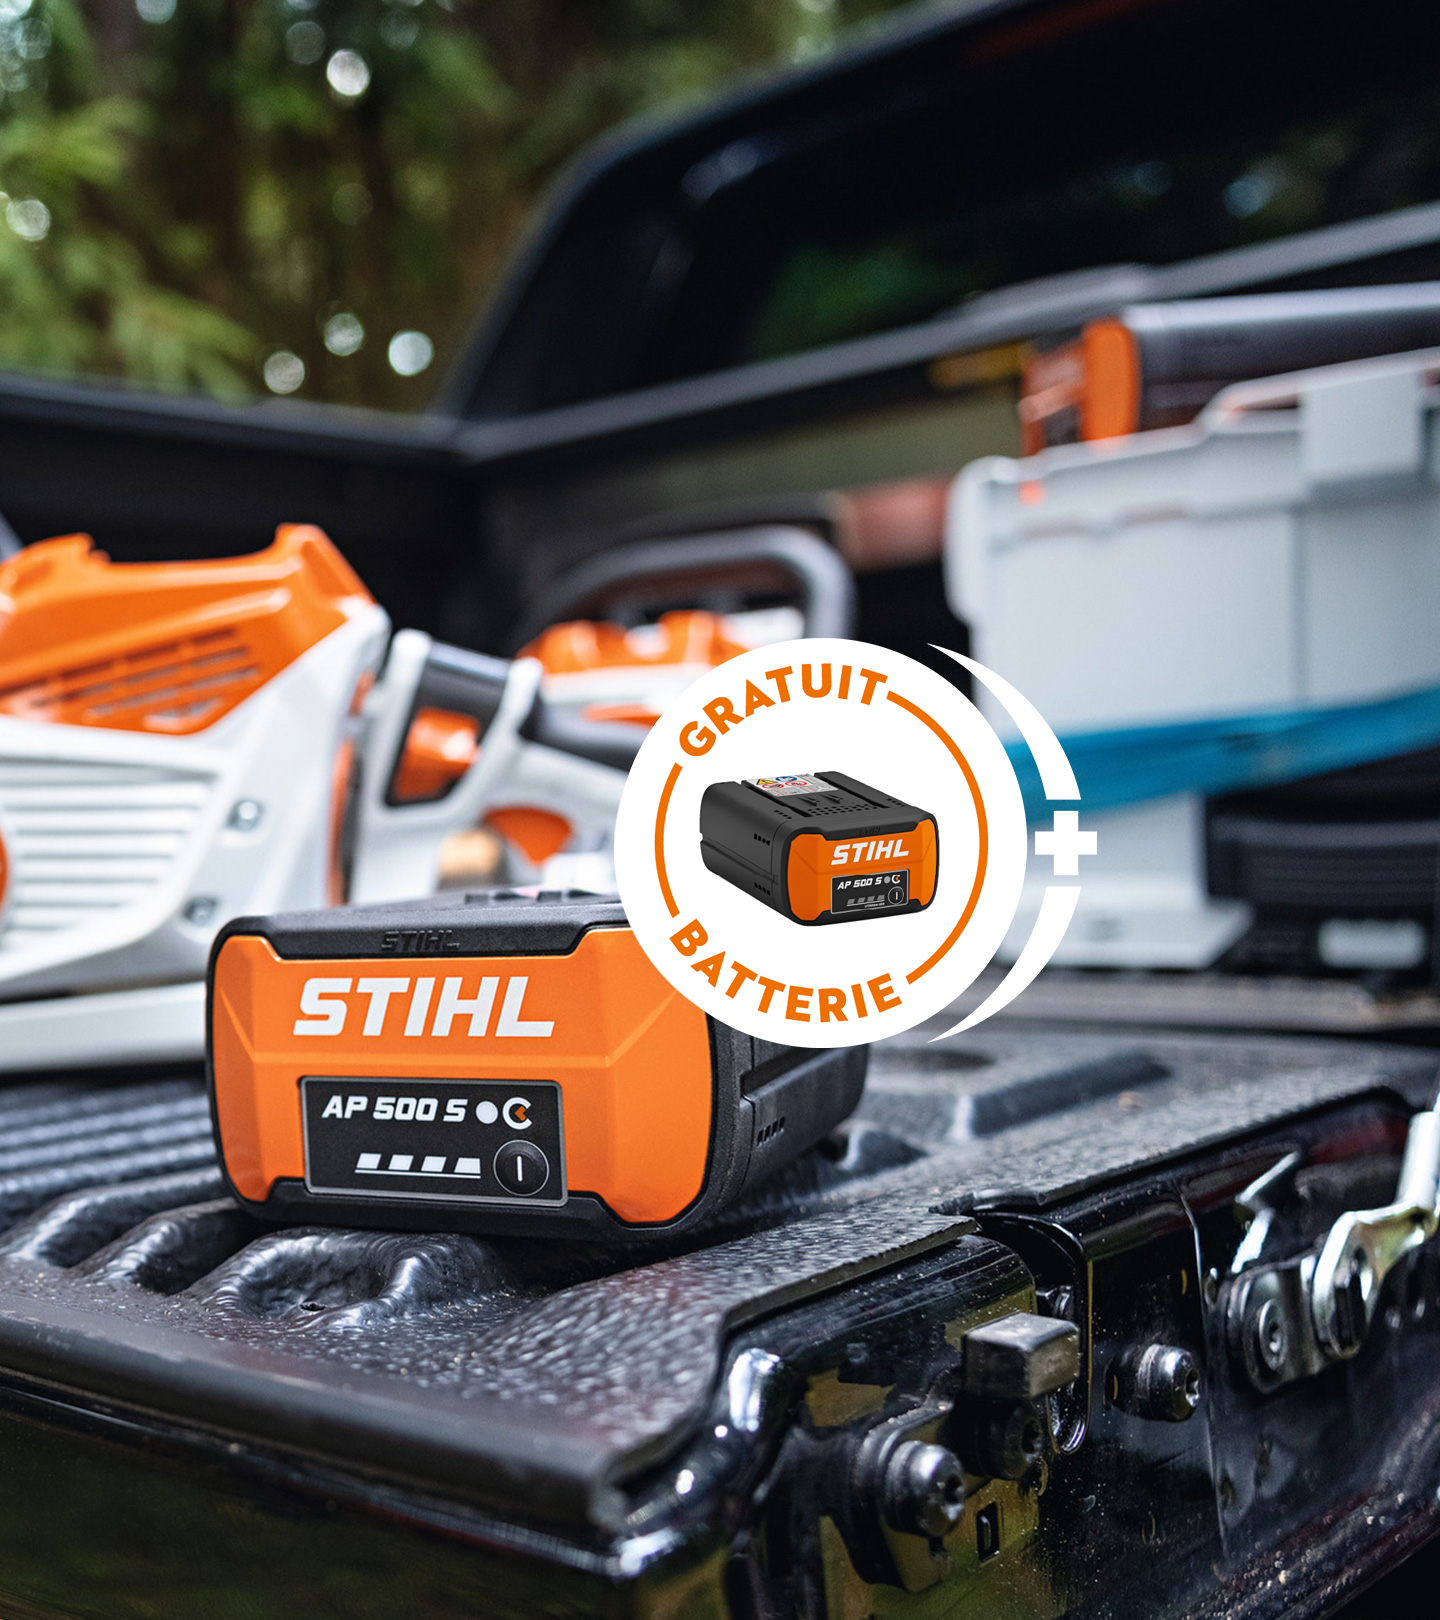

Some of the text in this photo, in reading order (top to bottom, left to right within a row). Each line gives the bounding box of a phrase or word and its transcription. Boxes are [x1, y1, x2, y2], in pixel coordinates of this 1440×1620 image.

[380, 930, 460, 949] STIHL
[292, 975, 555, 1038] STIHL
[321, 1095, 469, 1123] AP 500 S
